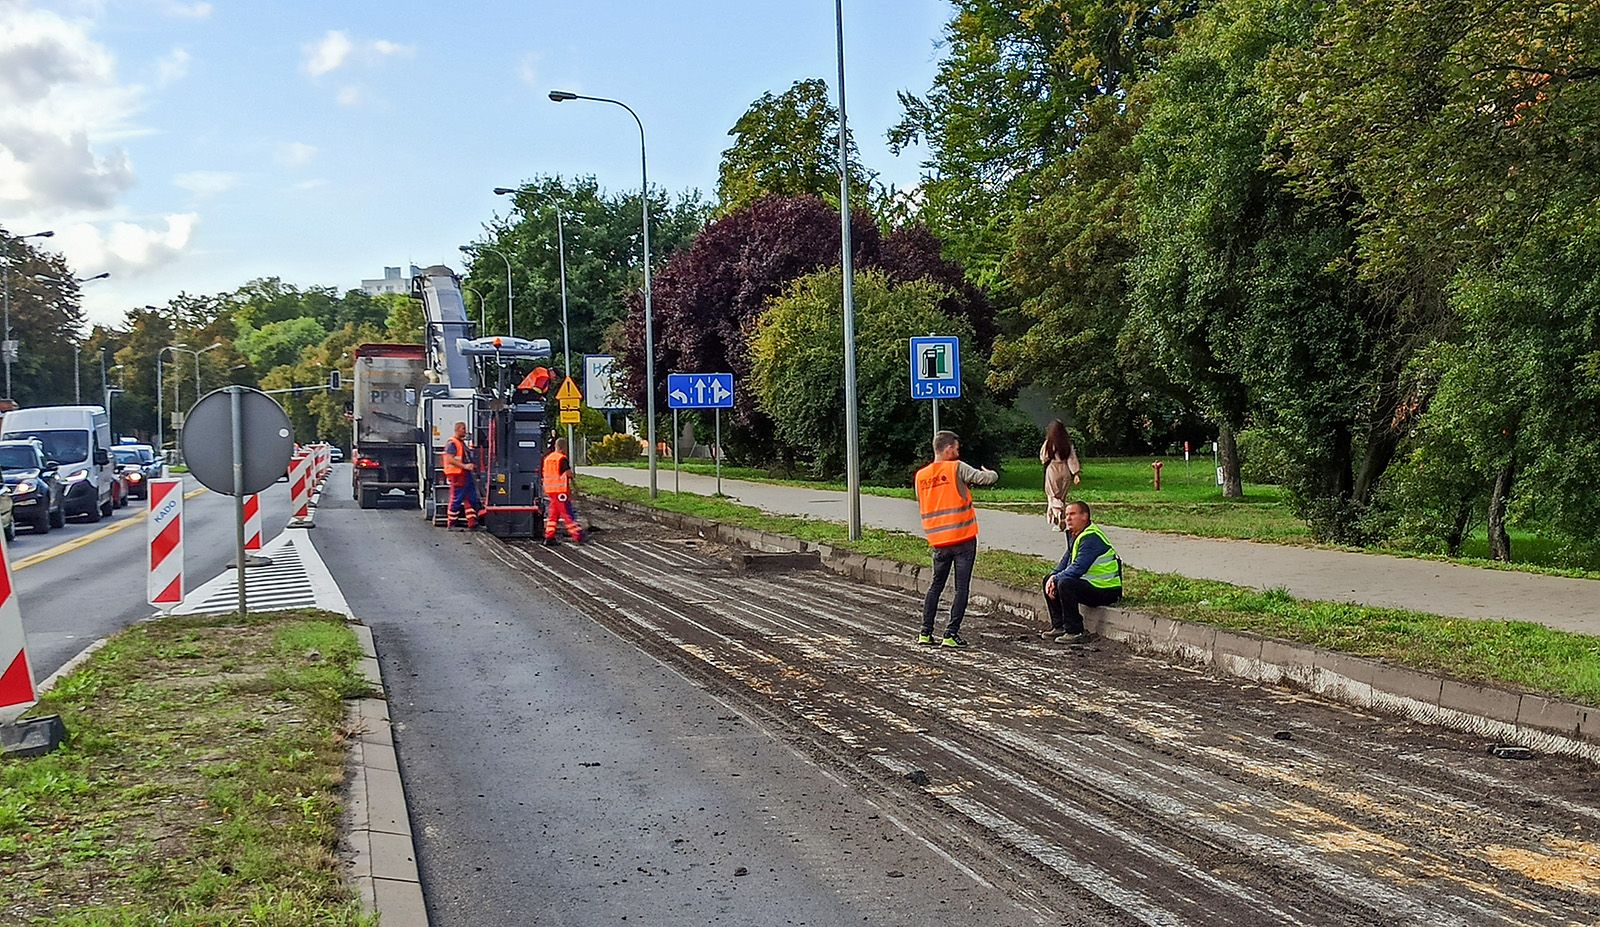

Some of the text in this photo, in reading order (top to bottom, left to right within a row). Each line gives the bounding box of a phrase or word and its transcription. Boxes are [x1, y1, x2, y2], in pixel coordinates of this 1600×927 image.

[915, 382, 957, 396] 1,5 km
[371, 390, 390, 403] PP
[154, 500, 177, 523] KADO
